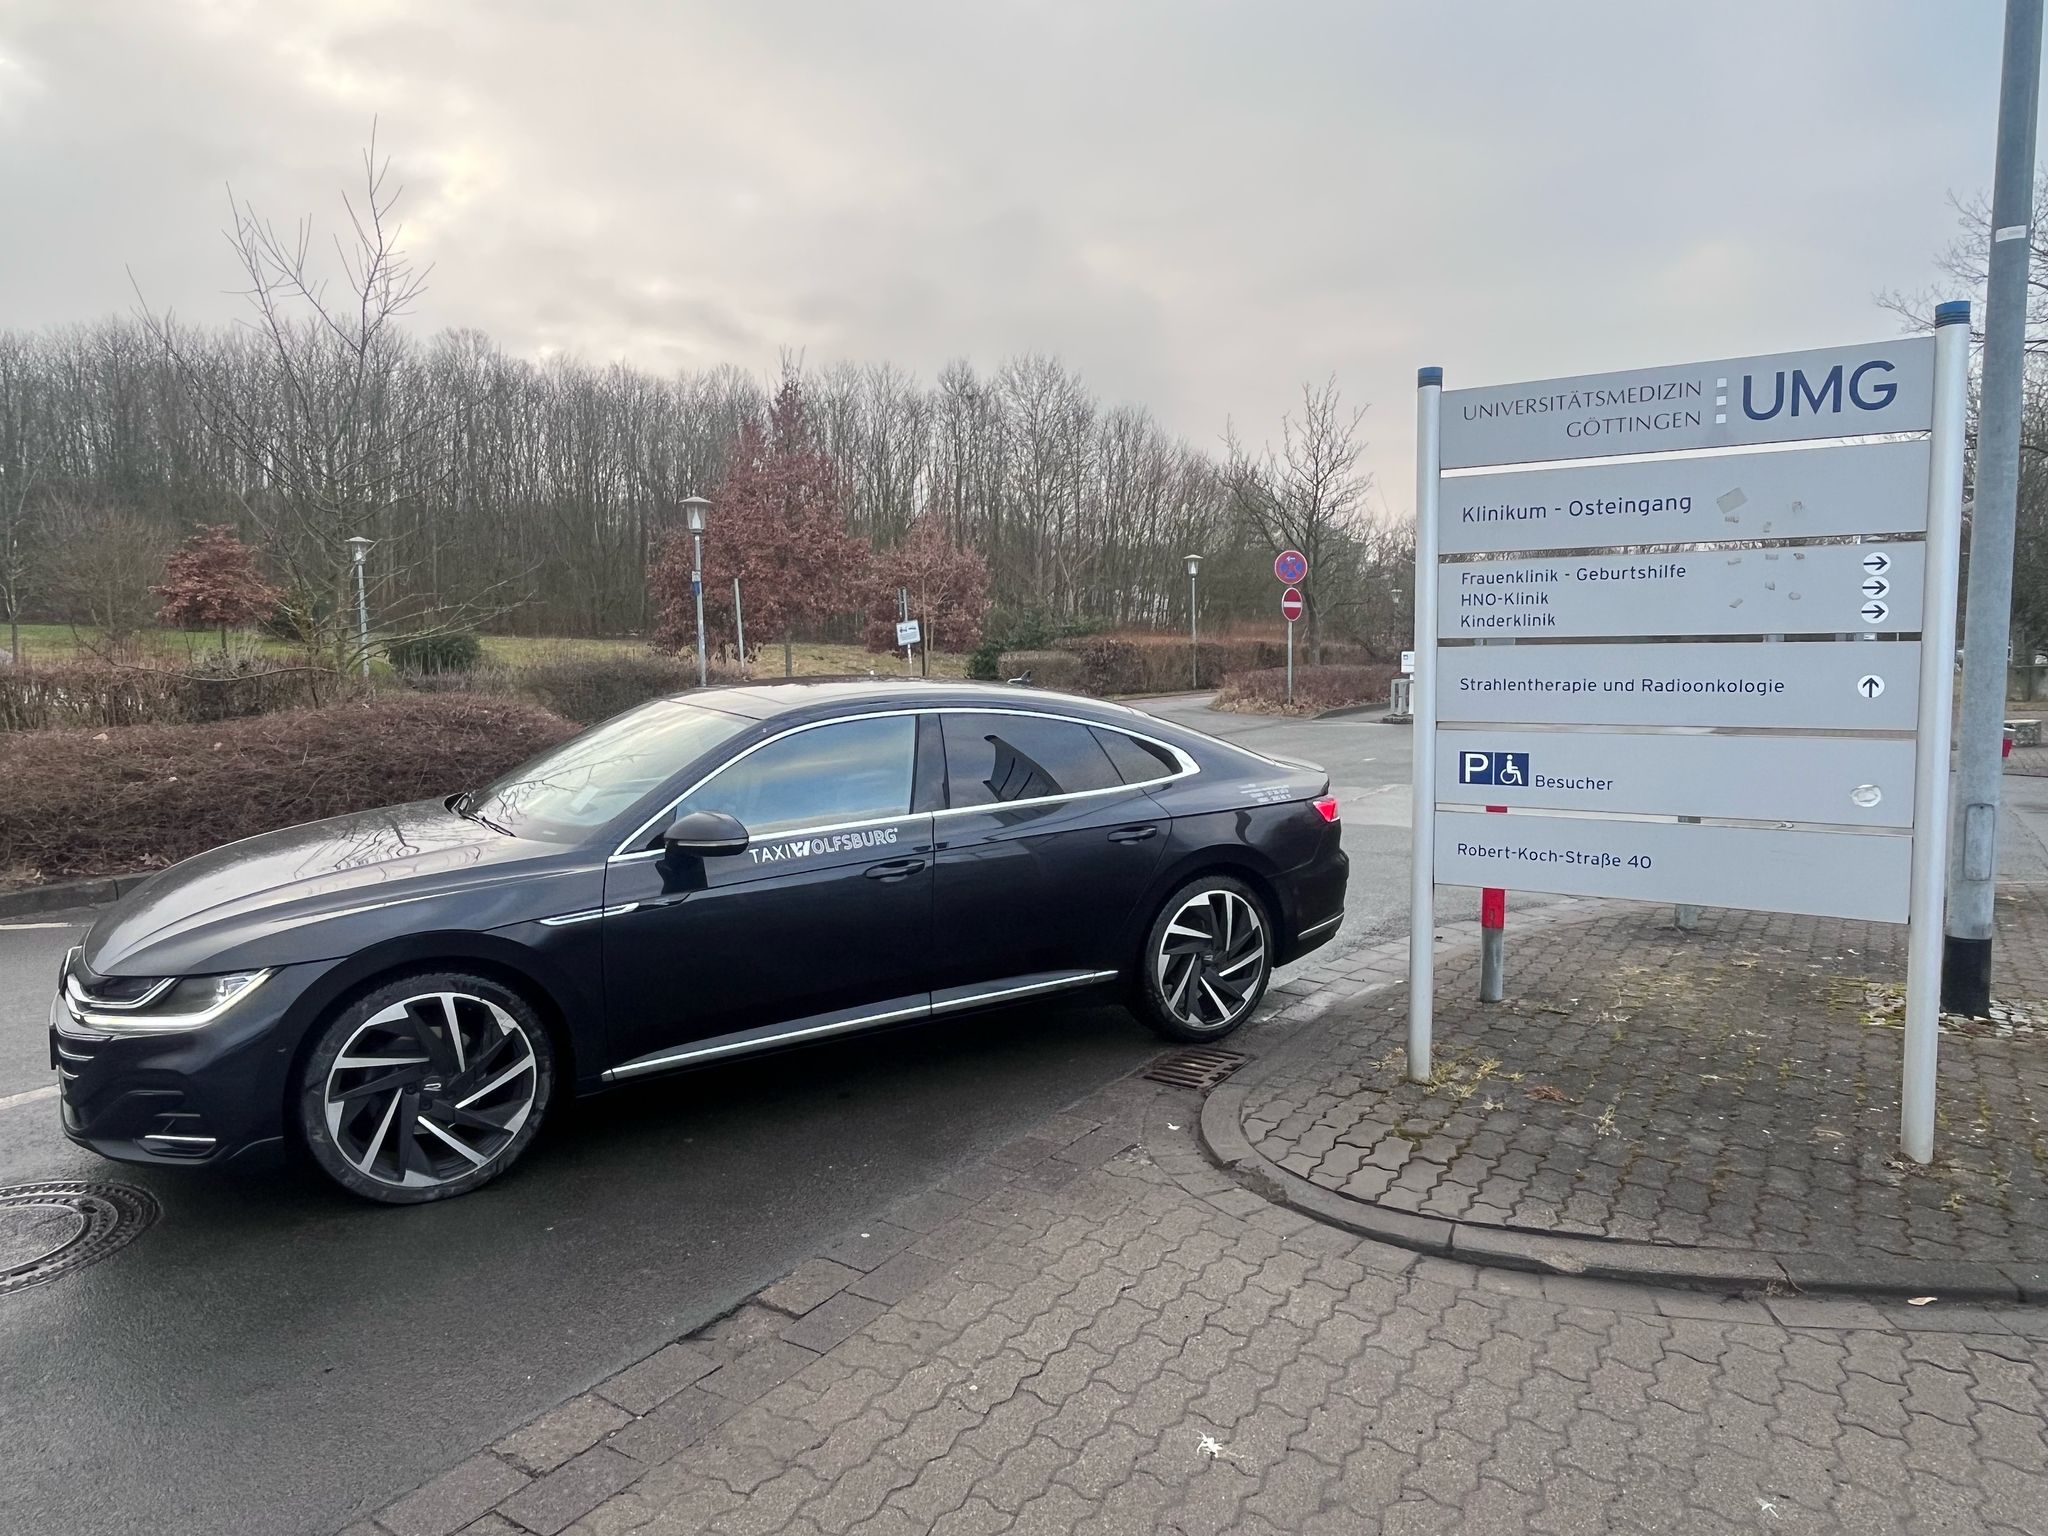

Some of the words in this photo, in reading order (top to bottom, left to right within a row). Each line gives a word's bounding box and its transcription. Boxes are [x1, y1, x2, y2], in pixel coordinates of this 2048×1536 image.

[1463, 380, 1701, 422] UNIVERSITÄTSMEDIZIN
[1743, 360, 1898, 421] UMG
[1566, 409, 1701, 438] GÖTTINGEN
[1462, 504, 1547, 523] Klinikum
[1569, 496, 1692, 517] Osteingang
[1461, 569, 1559, 585] Frauenklinik
[1576, 563, 1686, 581] Geburtshilfe
[1461, 591, 1549, 607] HNO-Klinik
[1460, 613, 1556, 628] Kinderklinik
[1460, 677, 1597, 694] Strahlentherapie
[1603, 679, 1635, 692] und
[1641, 678, 1785, 697] Radioonkologie
[1465, 753, 1489, 783] P
[1535, 774, 1614, 791] Besucher
[1457, 843, 1621, 869] Robert-Koch-Straße
[1627, 855, 1652, 869] 40
